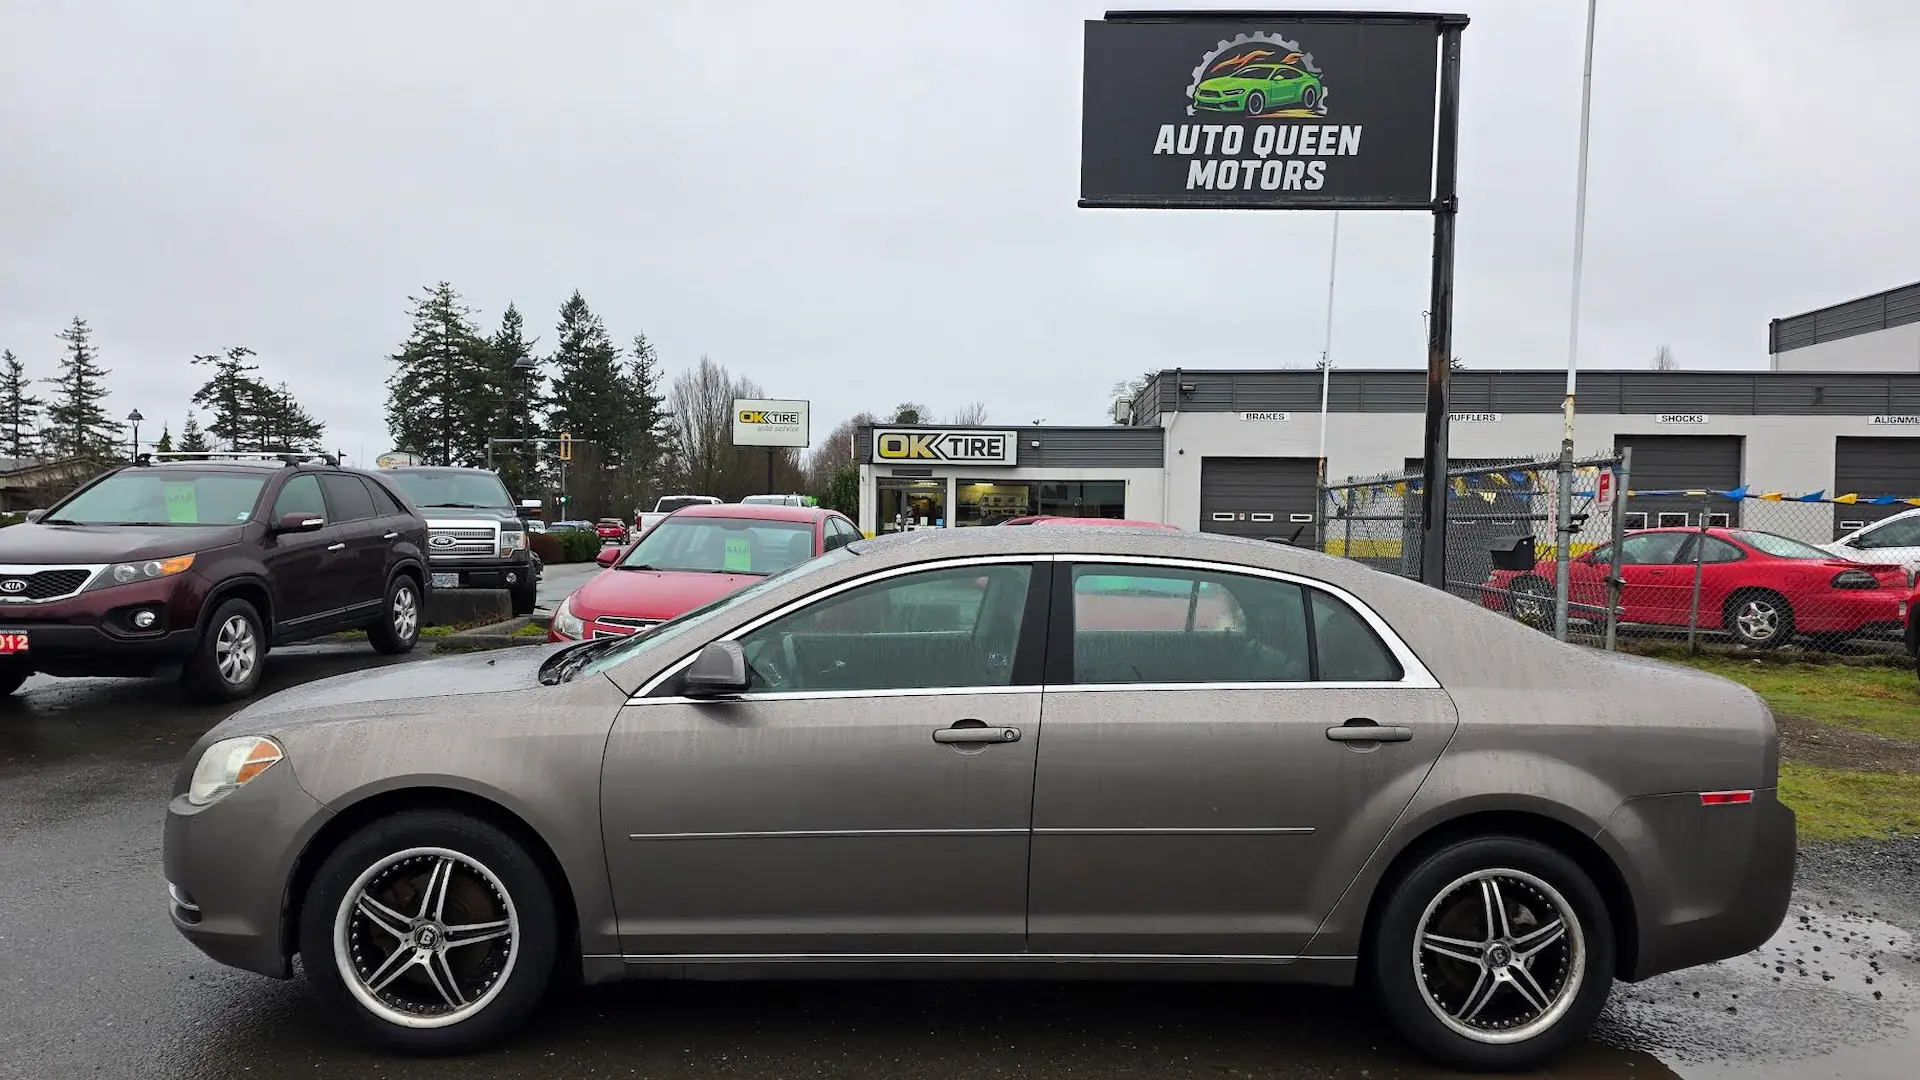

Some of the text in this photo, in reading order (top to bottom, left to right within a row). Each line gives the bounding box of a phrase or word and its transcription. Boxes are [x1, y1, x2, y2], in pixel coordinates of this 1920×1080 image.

[1153, 124, 1363, 158] AUTO QUEEN
[1186, 159, 1327, 191] MOTORS
[739, 410, 797, 424] OK TIRE
[1246, 412, 1285, 420] BRAKES
[1661, 414, 1703, 422] SHOCKS
[774, 425, 800, 433] service
[879, 433, 939, 459] OK
[949, 438, 1001, 457] TIRE
[4, 582, 21, 590] KIA
